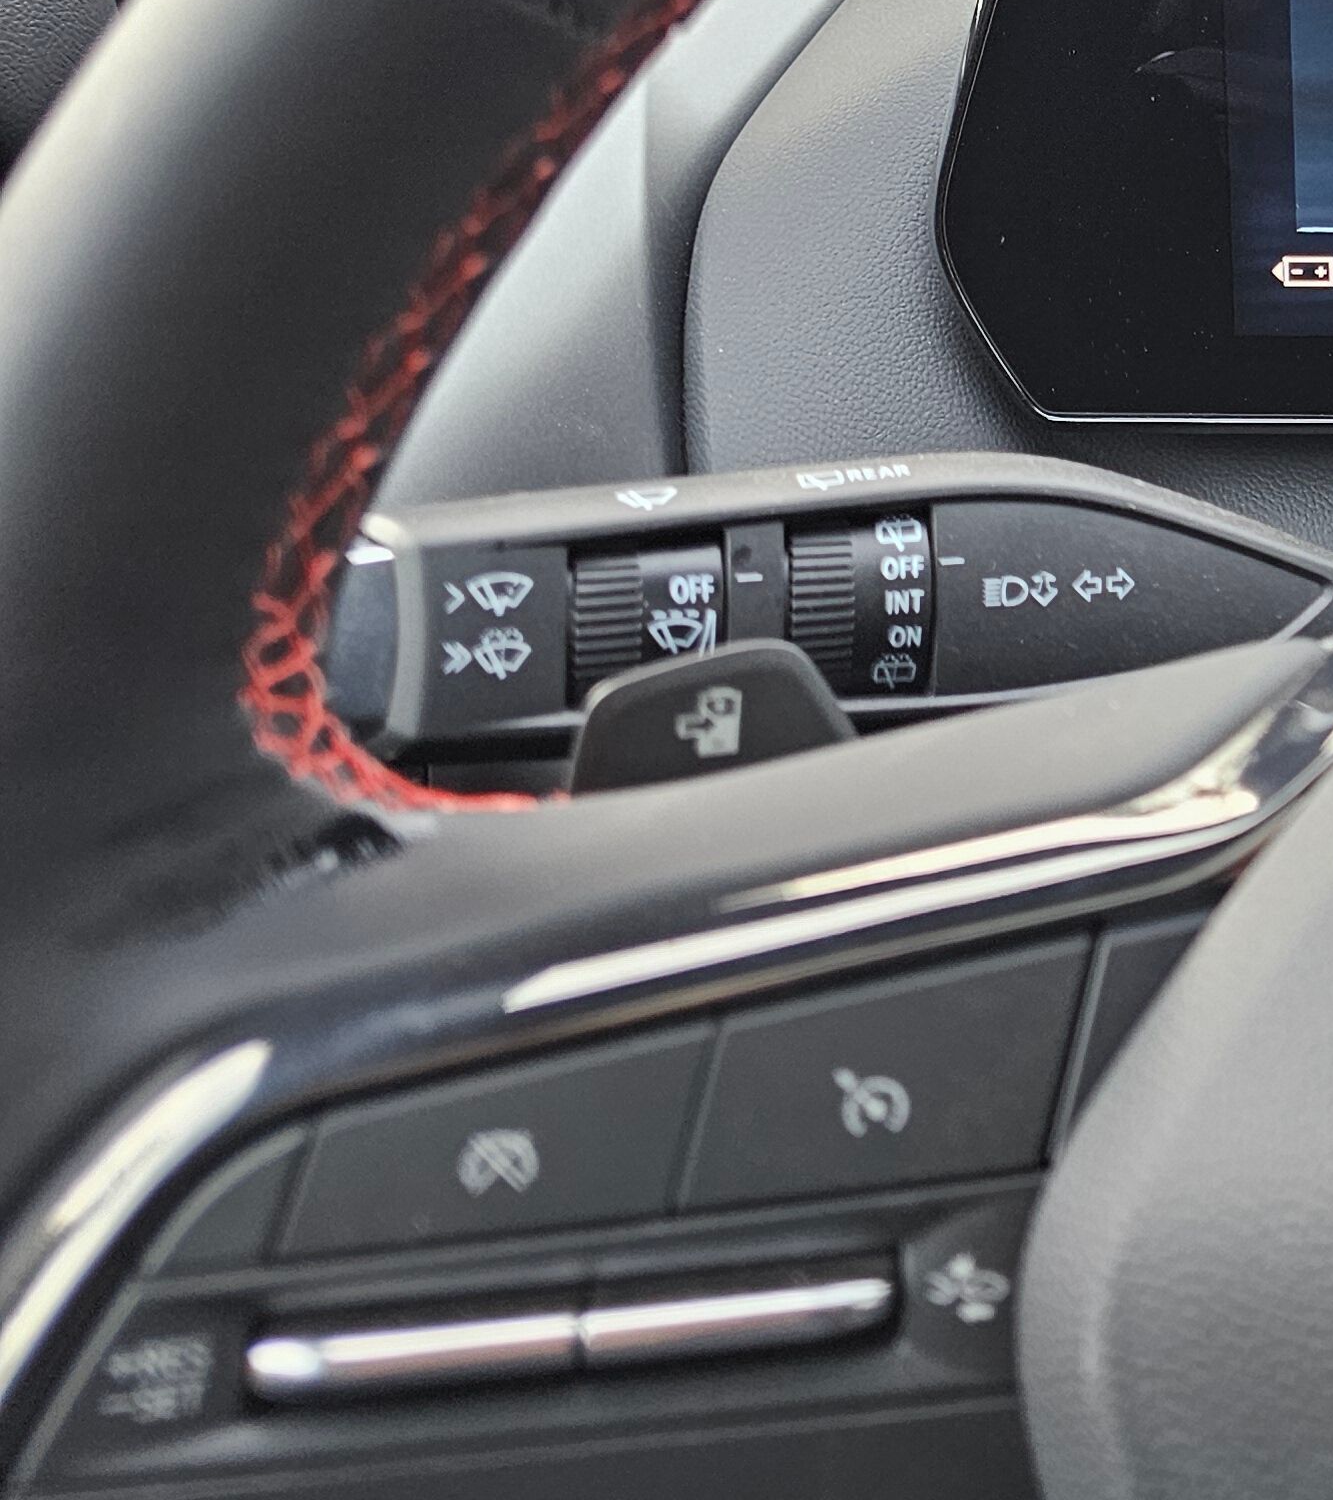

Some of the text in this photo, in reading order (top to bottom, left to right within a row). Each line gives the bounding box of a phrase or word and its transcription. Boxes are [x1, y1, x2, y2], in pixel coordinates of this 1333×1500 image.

[845, 463, 912, 484] REAR
[880, 553, 926, 581] OFF
[668, 572, 715, 605] OFF
[884, 588, 926, 615] INT
[887, 625, 923, 649] ON
